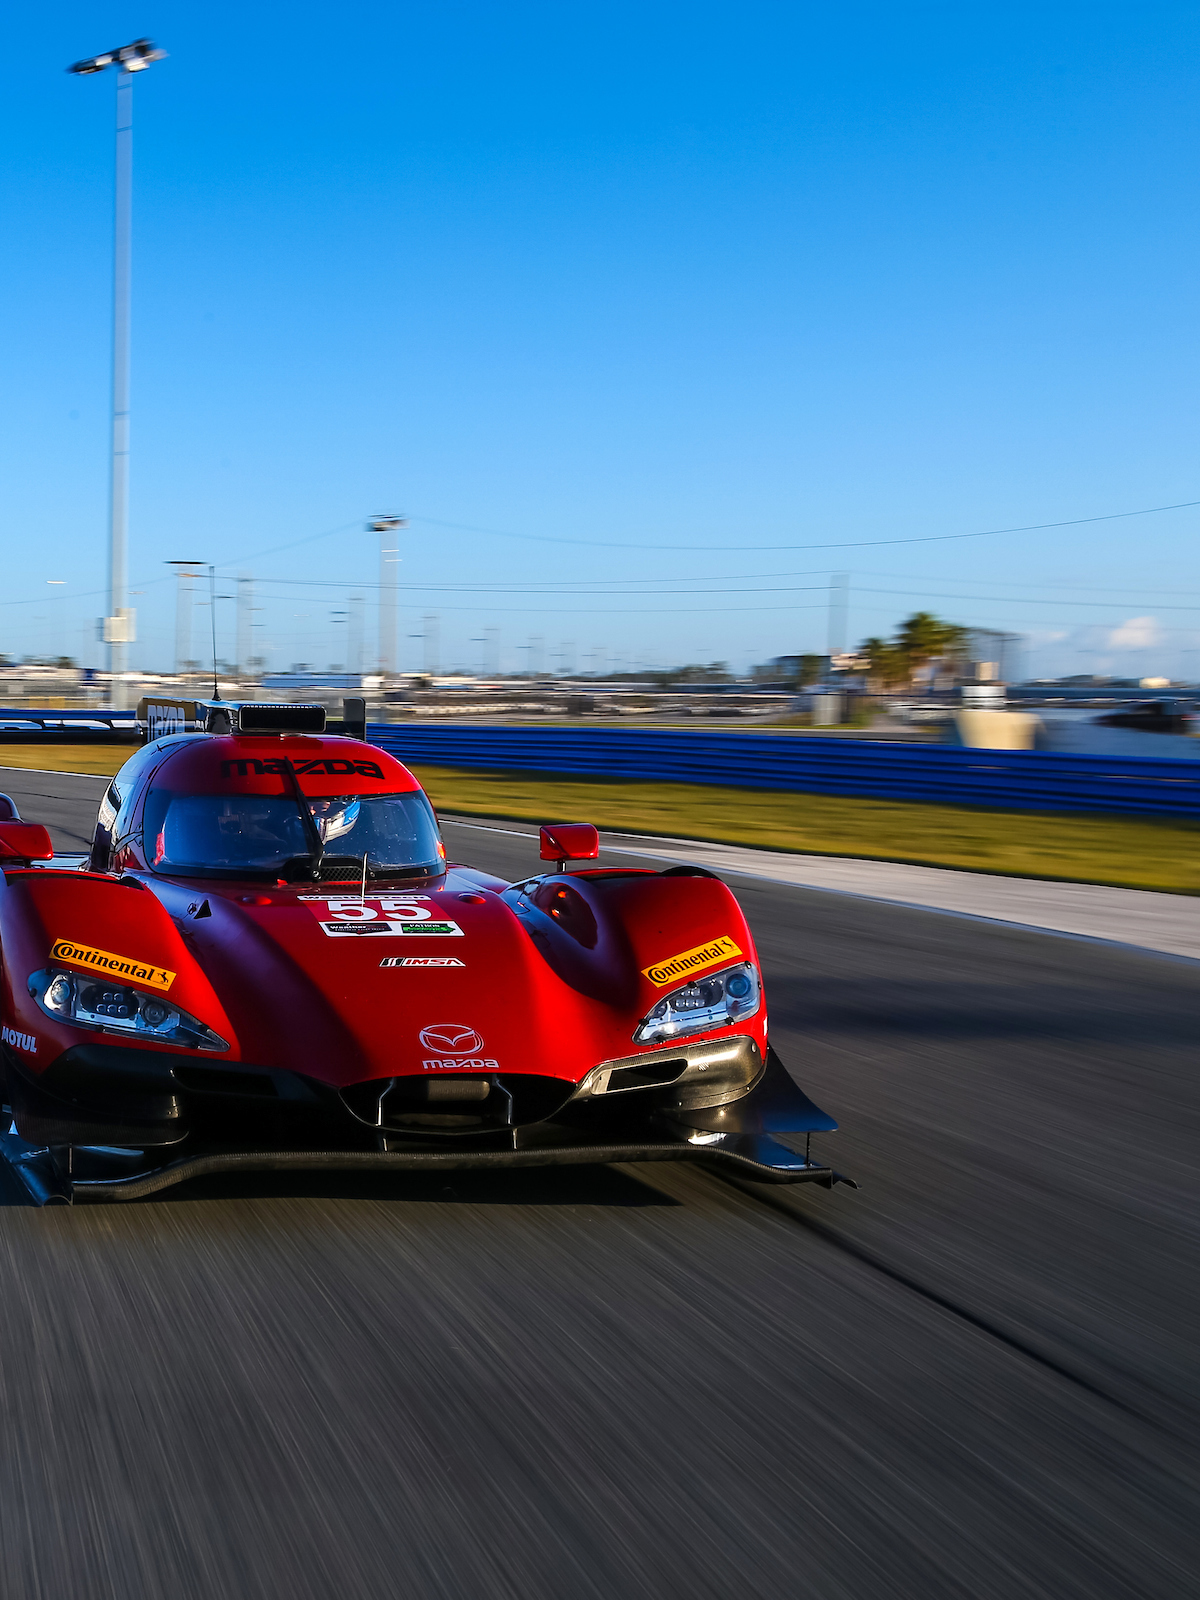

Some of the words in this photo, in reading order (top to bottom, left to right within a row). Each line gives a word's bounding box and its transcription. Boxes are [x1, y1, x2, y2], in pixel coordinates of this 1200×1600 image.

[327, 900, 432, 921] 55
[53, 942, 155, 981] Continental
[405, 957, 461, 965] IMSA
[647, 943, 726, 984] Continental
[1, 1025, 37, 1053] MOTUL
